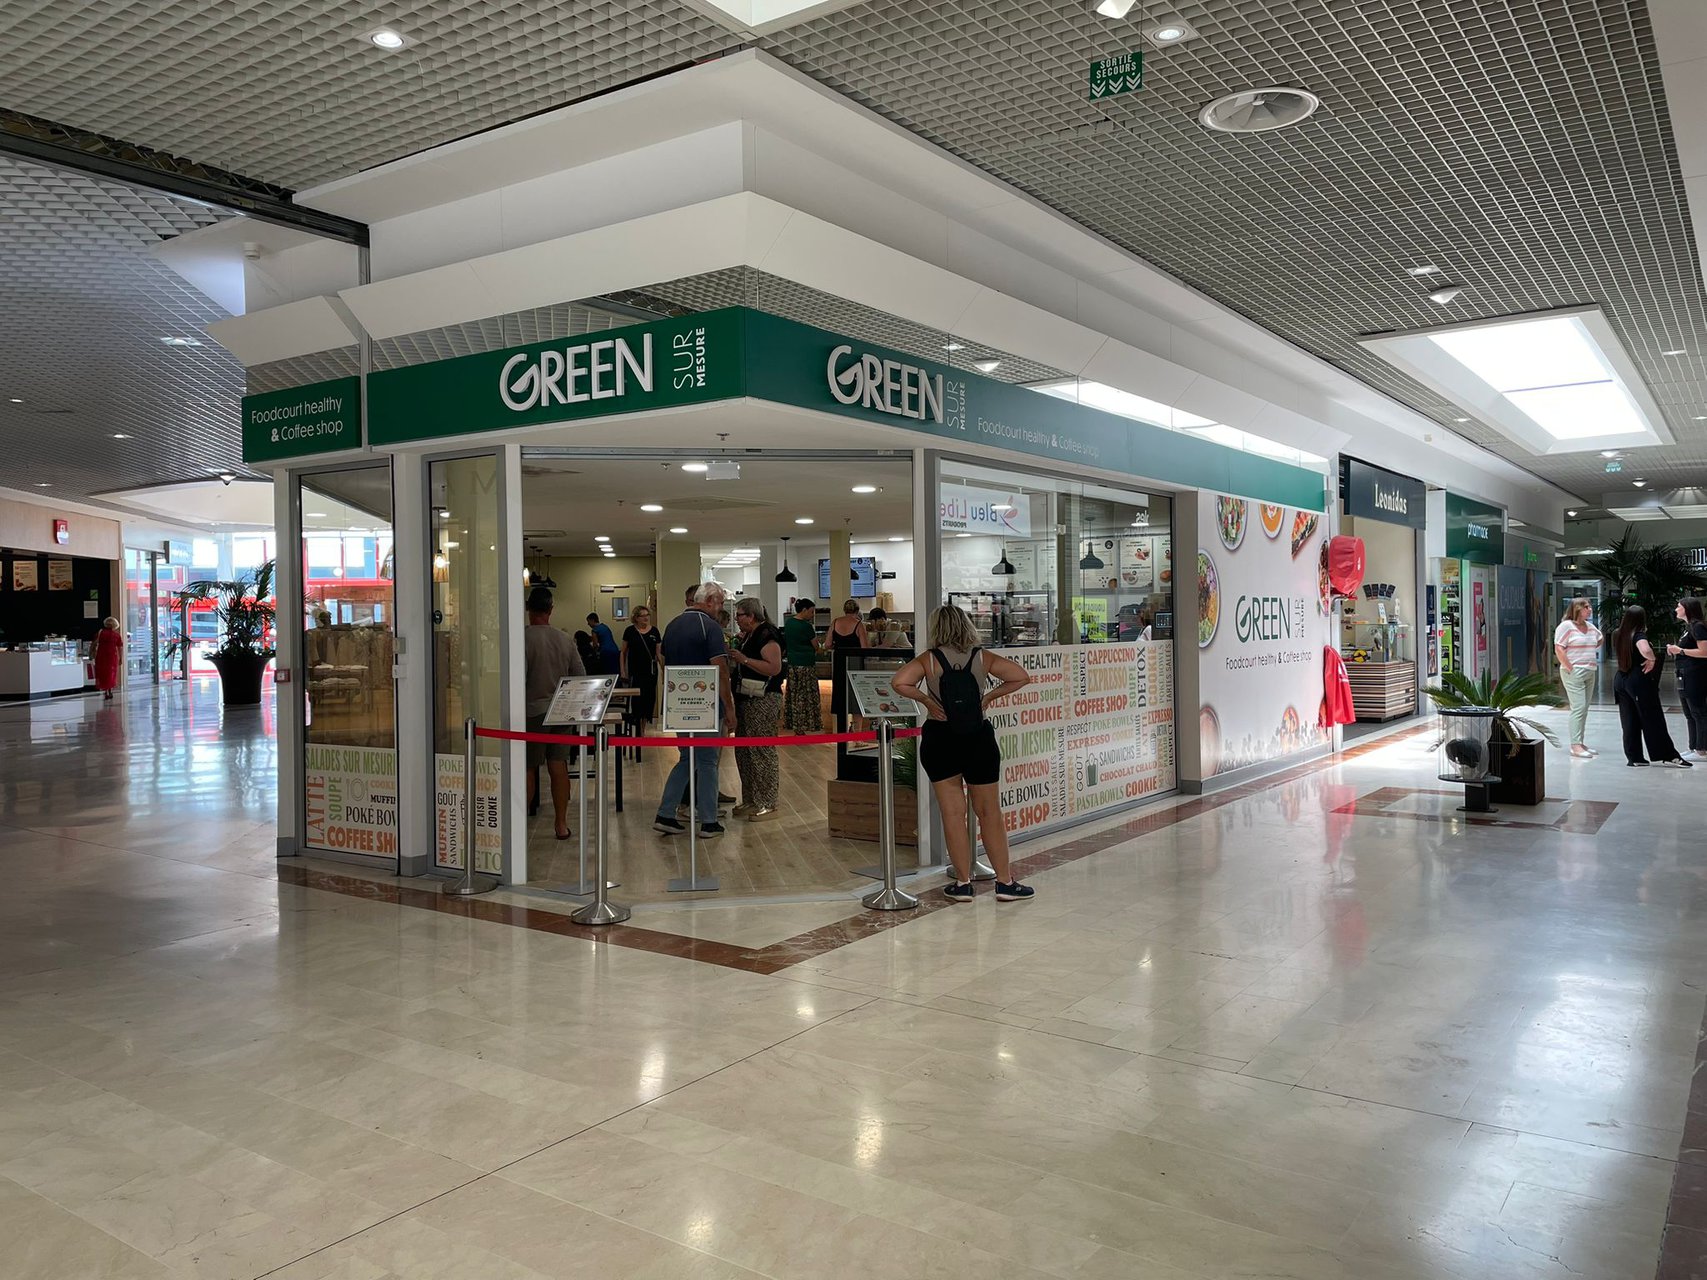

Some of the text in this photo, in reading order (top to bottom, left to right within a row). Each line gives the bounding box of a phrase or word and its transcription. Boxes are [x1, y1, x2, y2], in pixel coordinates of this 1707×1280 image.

[1096, 62, 1136, 79] SECOURS
[1100, 54, 1132, 69] SORTIE
[673, 334, 693, 390] SUR
[696, 326, 706, 388] MESURE
[500, 333, 654, 412] GREEN
[827, 345, 944, 424] GREEN
[251, 396, 342, 425] Foodcourt healthy
[947, 381, 959, 429] SUR
[270, 417, 344, 443] & Coffee shop
[978, 417, 1021, 440] Foodcourt
[1023, 427, 1050, 449] healthy
[1051, 434, 1058, 447] &
[1059, 435, 1082, 451] Coffee
[1374, 483, 1407, 515] Leonidas
[1235, 595, 1290, 643] GREEN
[1023, 653, 1062, 670] HEALTHY
[1087, 648, 1136, 665] CAPPUCCINO
[1226, 656, 1257, 670] Foodcourt
[1278, 651, 1282, 664] &
[1283, 651, 1300, 664] Coffee
[1040, 673, 1062, 683] SHOP
[1063, 653, 1071, 720] MUFFIN
[1088, 666, 1128, 693] EXPRESSO
[1137, 646, 1146, 708] DETOX
[1148, 646, 1157, 706] COOKIE
[1012, 691, 1039, 706] CHAUD
[1040, 687, 1063, 702] SOUPE
[1074, 694, 1128, 717] COFFEE SHOP
[1021, 705, 1062, 726] COOKIE
[1067, 721, 1092, 736] RESPECT
[1112, 715, 1134, 729] BOWLS
[1148, 708, 1173, 724] EXPRESSO
[1000, 728, 1057, 762] SUR MESURE
[1067, 734, 1110, 751] EXPRESSO
[1100, 745, 1136, 766] SANDWICHS
[306, 747, 341, 771] SALADES
[343, 749, 360, 773] SUR
[1005, 759, 1049, 784] CAPPUCCINO
[1075, 755, 1083, 792] GOÛT
[1100, 761, 1157, 782] CHOCOLAT CHAUD
[437, 790, 458, 806] GOÛT
[478, 778, 498, 792] HOP
[1000, 781, 1050, 808] KÉ BOWLS
[1059, 778, 1067, 817] SALADES
[1076, 775, 1157, 812] PASTA BOWLS COOKIE
[307, 776, 325, 845] LATTE
[329, 776, 342, 822] SOUPE
[477, 796, 485, 827] PLAISIR
[488, 795, 498, 829] COOKIE
[346, 805, 374, 825] POKÉ
[1019, 802, 1050, 828] SHOP
[327, 825, 374, 852] COFFEE
[438, 807, 447, 864] MUFFIN
[449, 807, 457, 865] SANDWICHS
